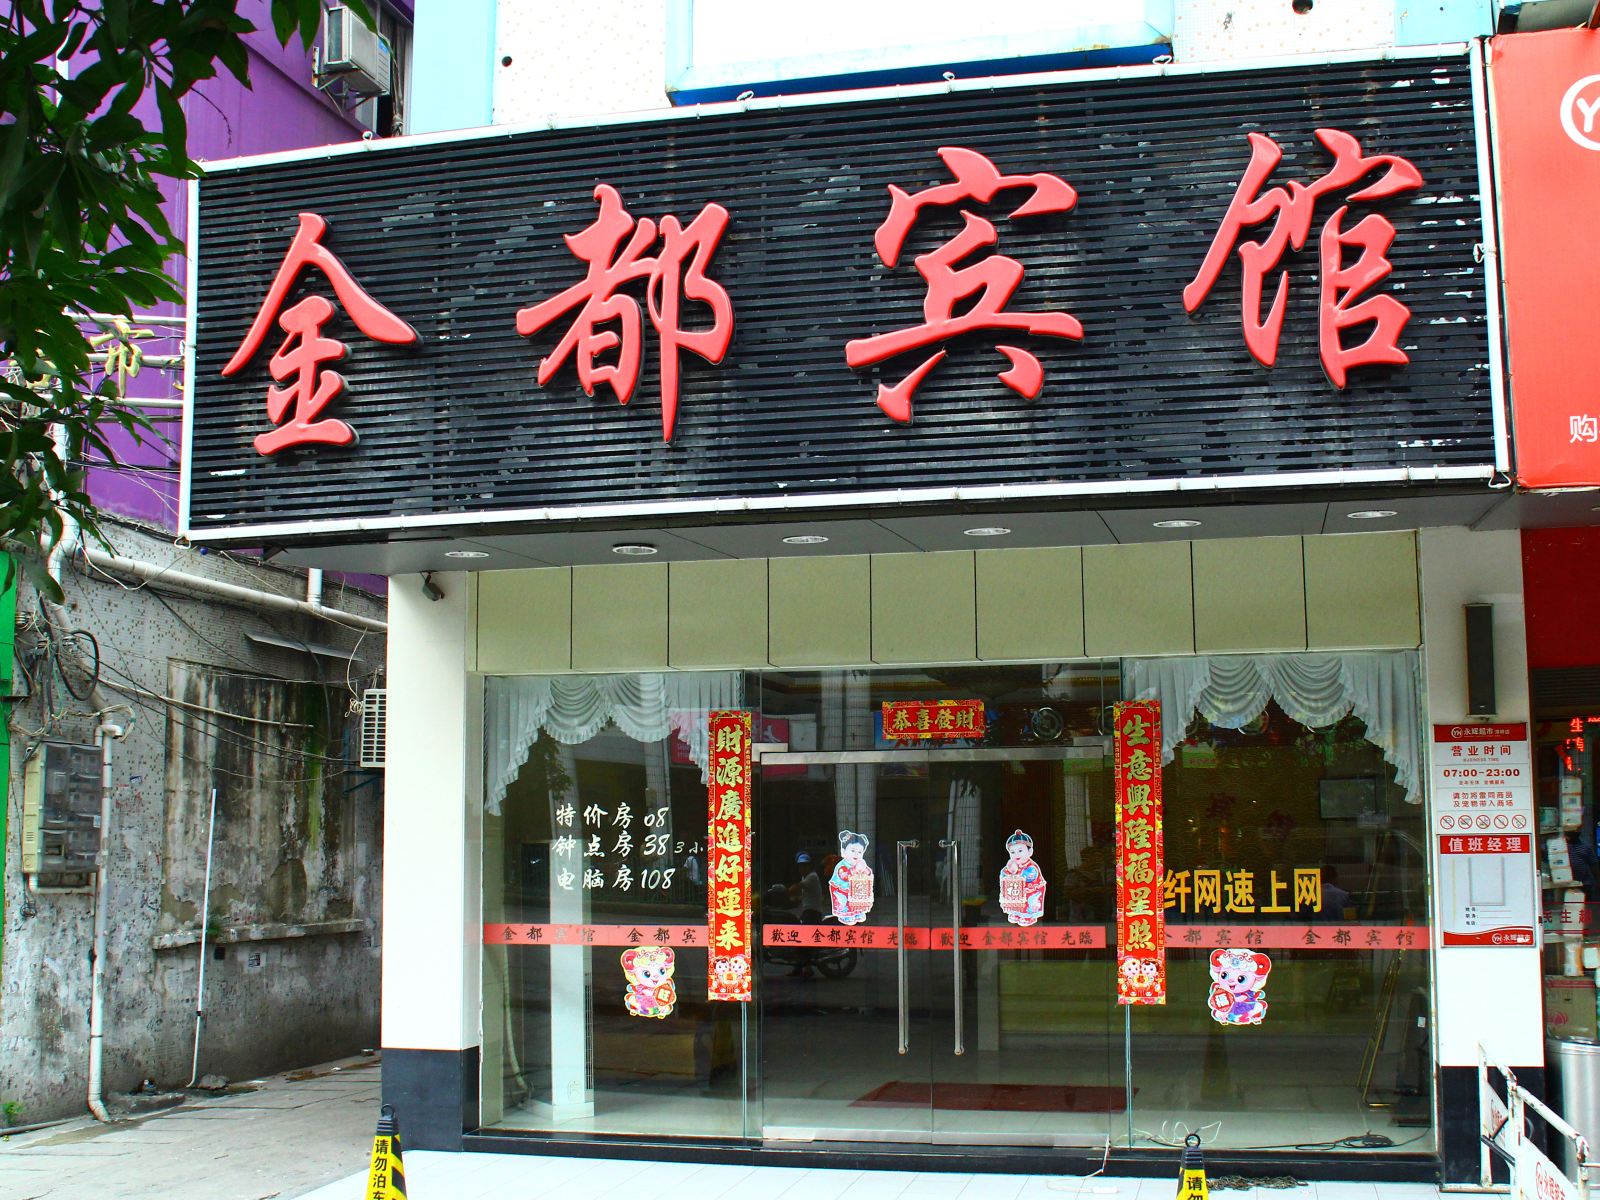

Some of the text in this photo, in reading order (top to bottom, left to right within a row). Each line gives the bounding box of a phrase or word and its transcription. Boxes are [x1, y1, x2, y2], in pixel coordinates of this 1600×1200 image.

[221, 127, 1423, 457] 金都宾馆
[892, 707, 975, 731] 恭喜發財
[1451, 745, 1511, 757] 营业时间
[1443, 768, 1520, 778] 07:00-23:00
[556, 802, 634, 828] 特价房
[552, 831, 634, 861] 钟点房
[643, 833, 671, 856] 38
[1448, 837, 1522, 852] 值班经理
[556, 864, 676, 891] 电脑房 108
[811, 928, 875, 944] 金都宾馆
[1301, 929, 1416, 946] 金都宾馆
